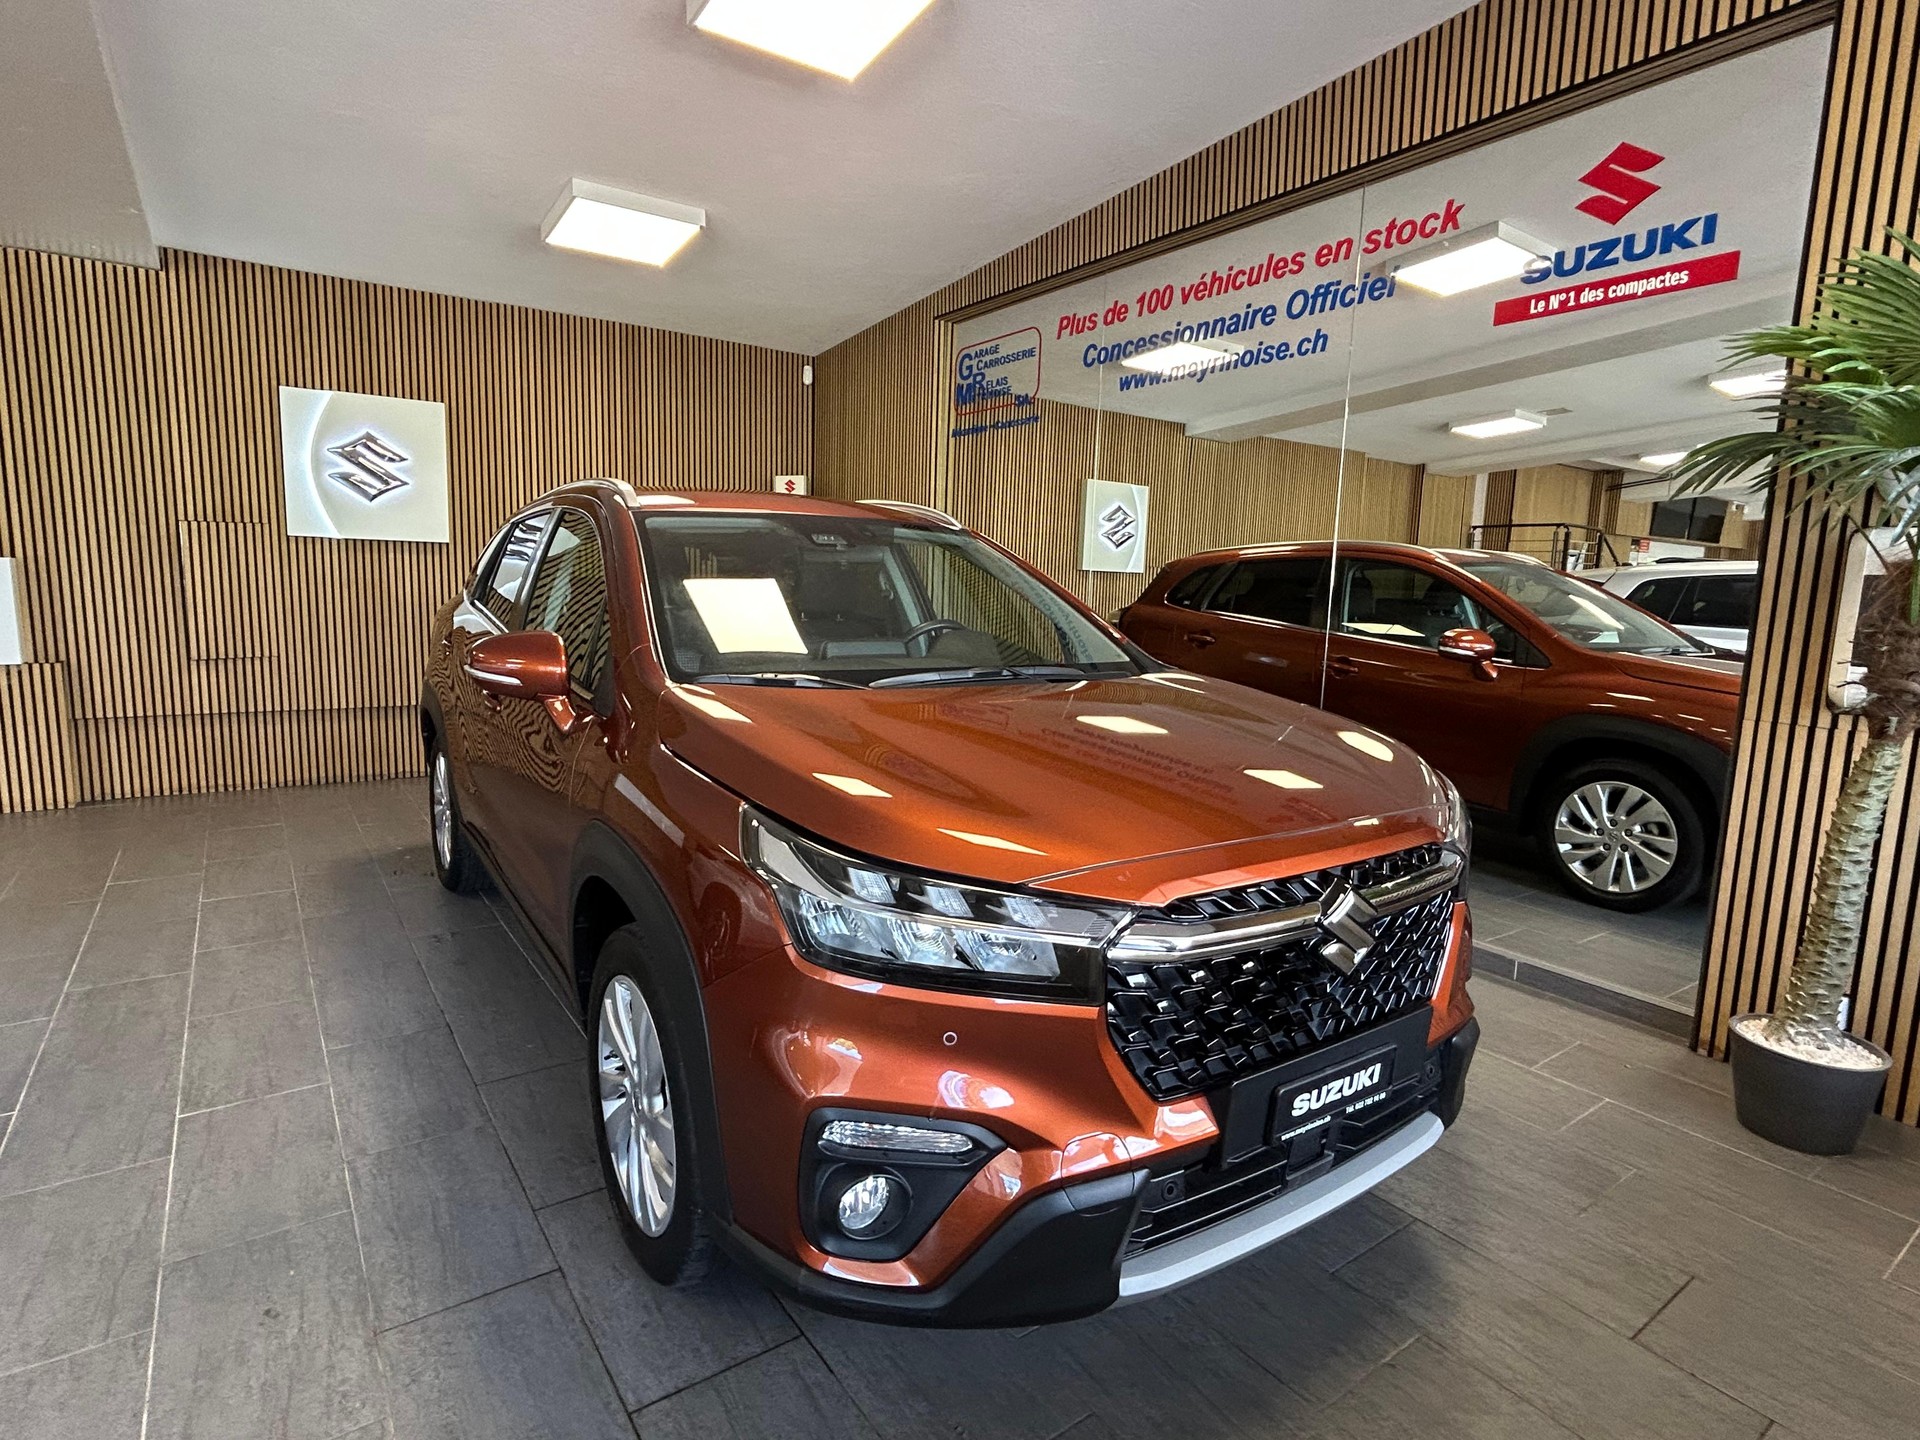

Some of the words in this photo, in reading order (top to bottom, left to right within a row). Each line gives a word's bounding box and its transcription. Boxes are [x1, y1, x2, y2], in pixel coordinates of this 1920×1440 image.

[1056, 312, 1098, 340] Plus
[1103, 300, 1129, 327] de
[1136, 284, 1174, 317] 100
[1180, 251, 1306, 305] véhicules
[1315, 237, 1354, 268] en
[1362, 198, 1465, 254] stock
[1520, 213, 1718, 284] SUZUKI
[1083, 303, 1277, 368] Concessionnaire
[1286, 264, 1400, 320] Officiel
[1530, 299, 1545, 314] Le
[1580, 287, 1604, 304] des
[1608, 269, 1689, 299] compactes
[977, 347, 1037, 371] CARROSSERIE
[1119, 328, 1329, 391] www.meyrinoise.ch
[1291, 1062, 1382, 1117] SUZUKI
